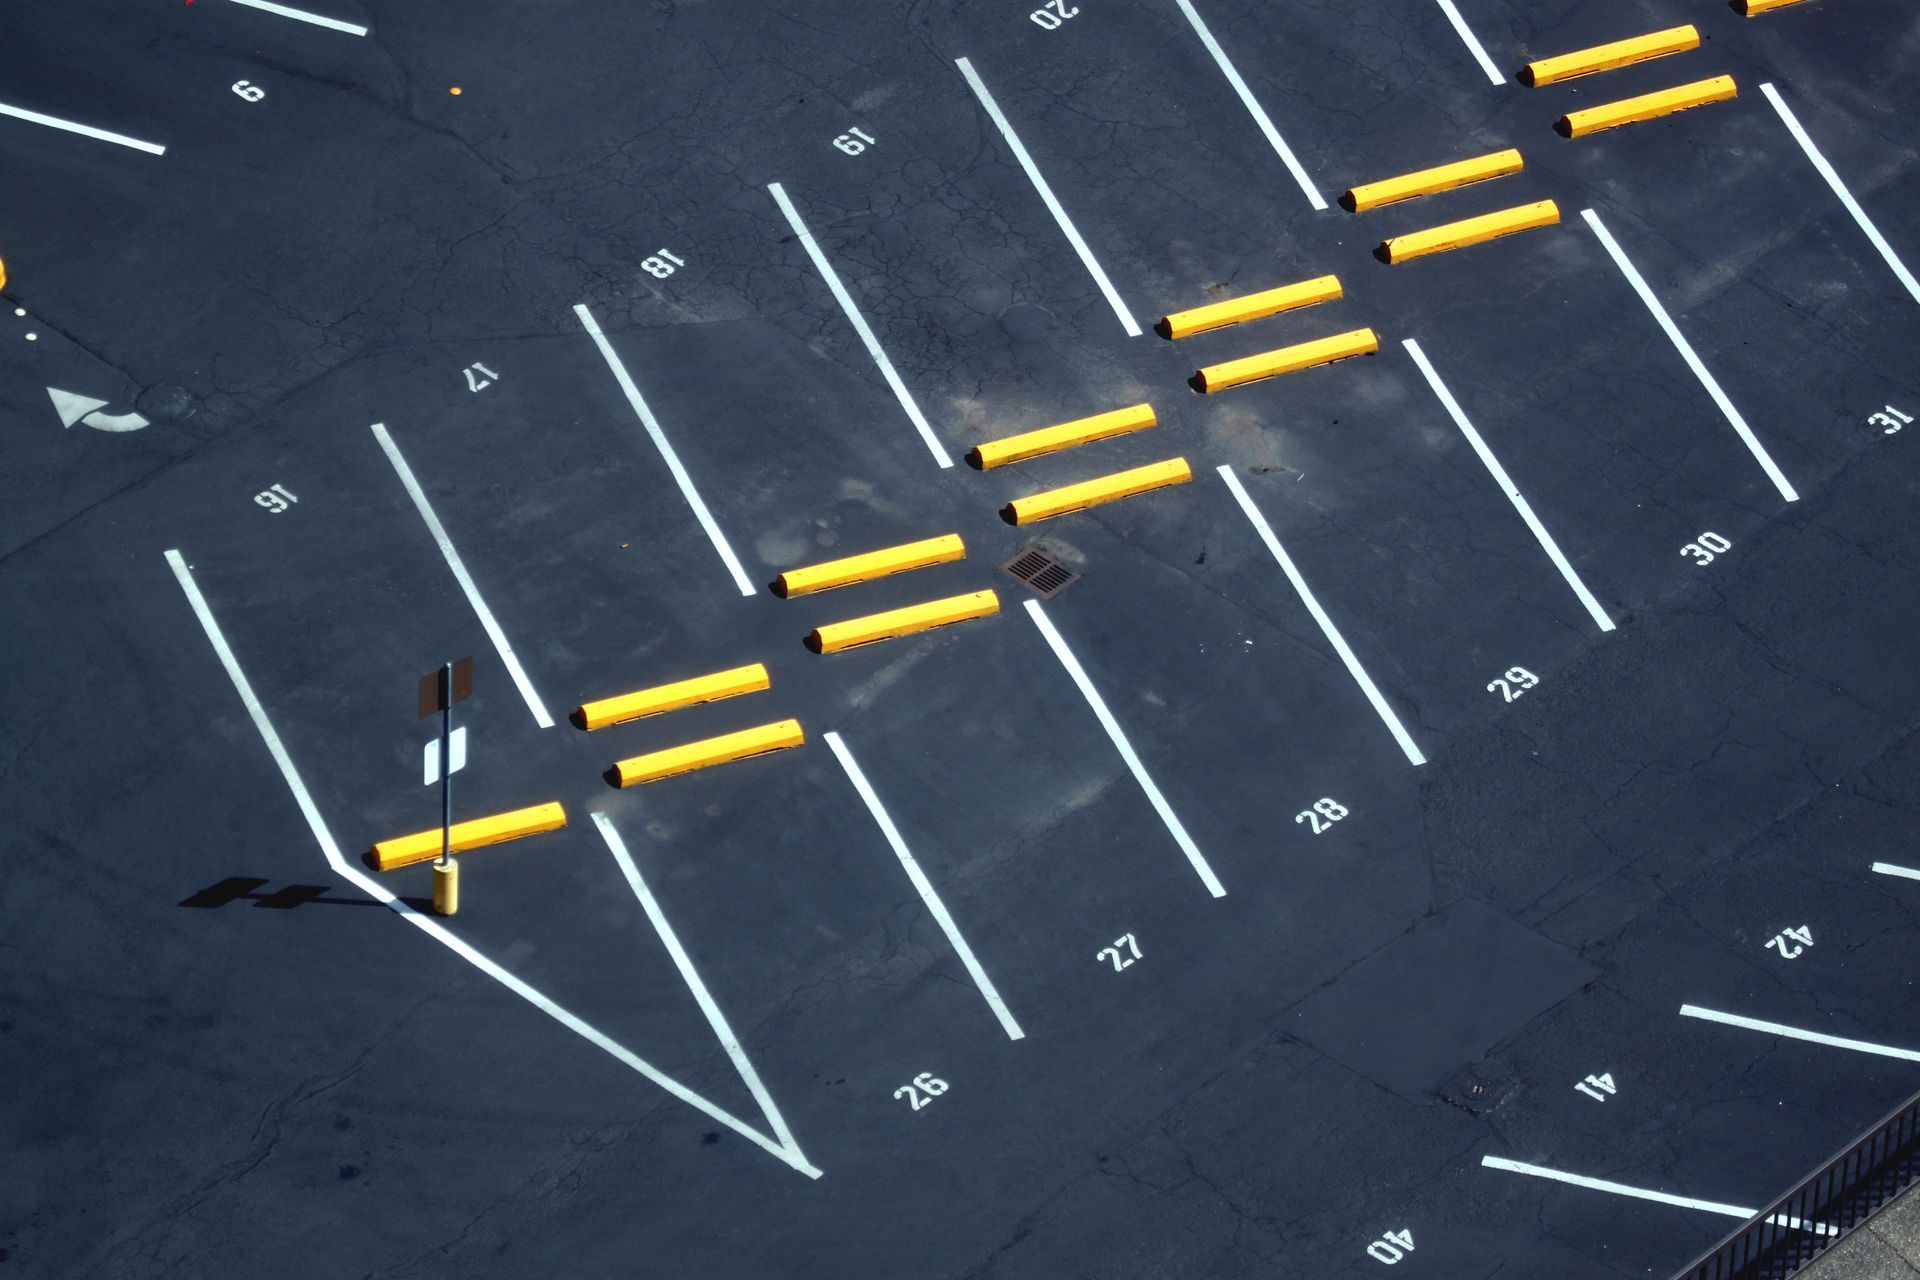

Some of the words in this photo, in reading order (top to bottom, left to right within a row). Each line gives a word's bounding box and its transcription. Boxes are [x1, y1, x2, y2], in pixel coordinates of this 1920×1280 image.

[1030, 0, 1079, 29] 20
[833, 127, 875, 155] 19
[641, 249, 684, 278] 18
[463, 362, 498, 392] 17
[1868, 405, 1914, 434] 31
[254, 484, 297, 513] 16
[1680, 532, 1731, 565] 30
[1487, 667, 1539, 703] 29
[1295, 798, 1348, 834] 28
[1097, 933, 1143, 972] 27
[1765, 925, 1813, 959] 42
[894, 1072, 949, 1111] 26
[1575, 1073, 1616, 1102] 41
[1367, 1229, 1414, 1264] 40
